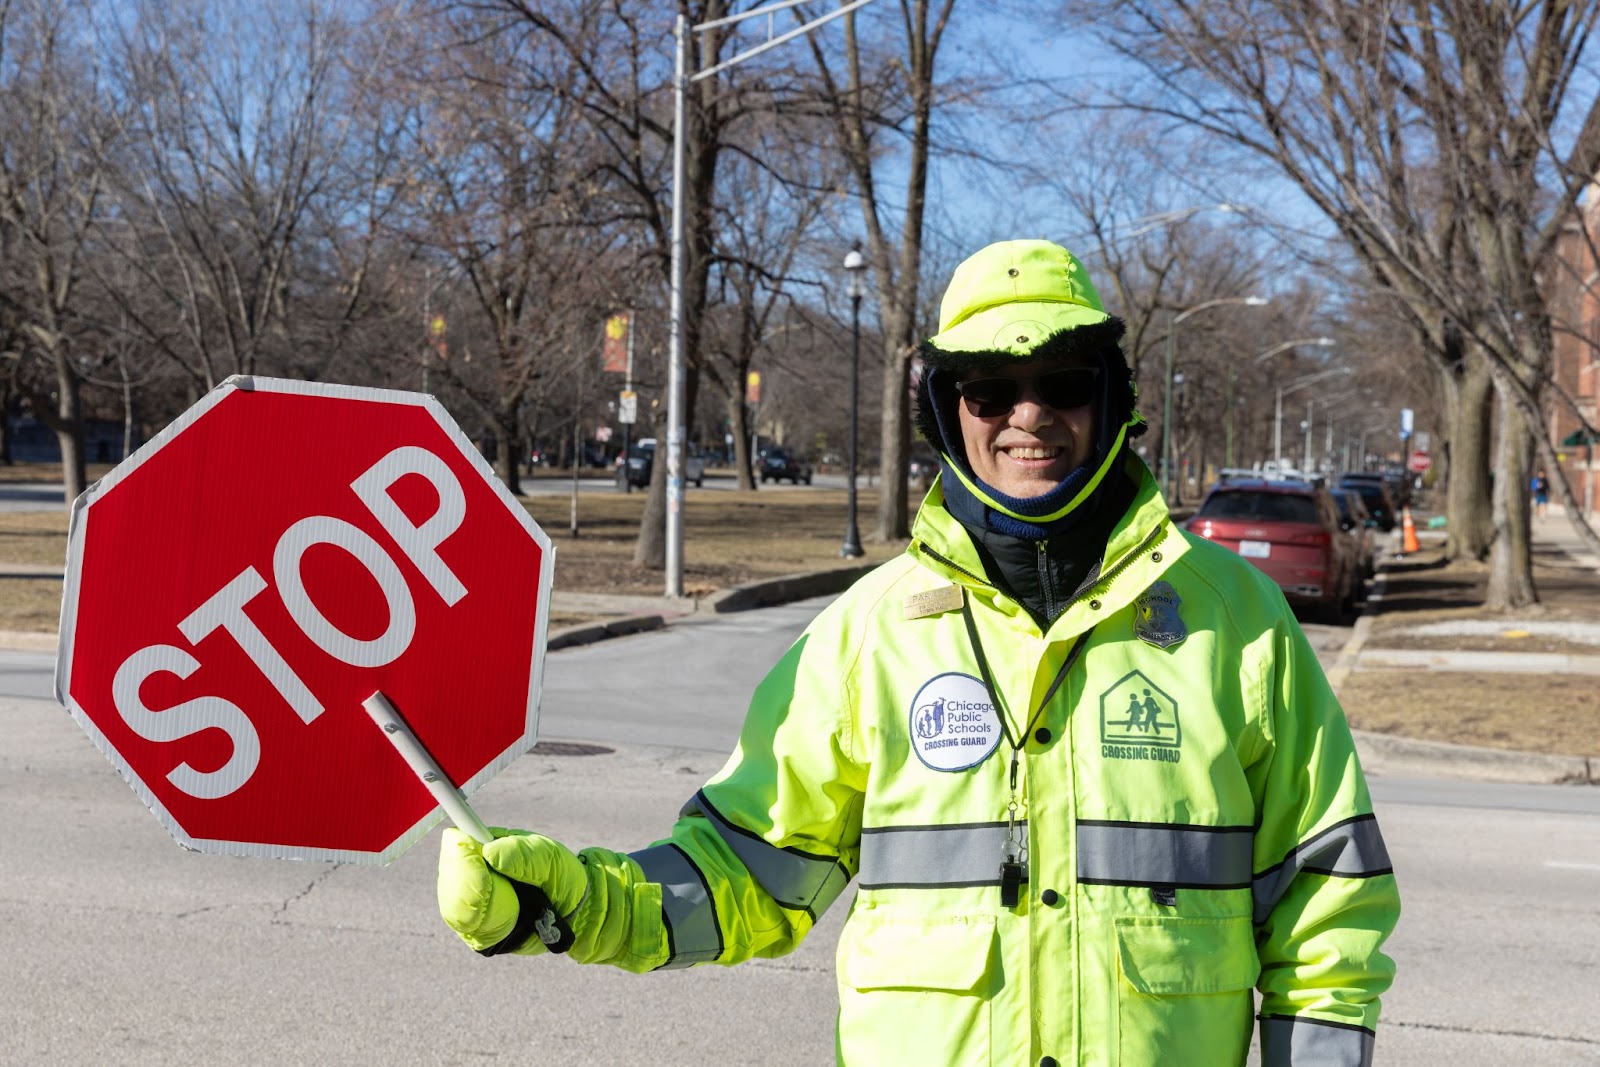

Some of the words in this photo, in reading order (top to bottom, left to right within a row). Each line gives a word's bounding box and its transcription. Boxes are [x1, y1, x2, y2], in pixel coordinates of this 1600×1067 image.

[112, 446, 469, 800] STOP
[947, 700, 996, 713] Chicago
[947, 711, 982, 723] Public
[948, 723, 991, 734] Schools
[924, 738, 959, 751] CROSSING
[961, 736, 987, 746] GUARD
[1101, 745, 1149, 760] CROSSING
[1150, 747, 1181, 764] GUARD
